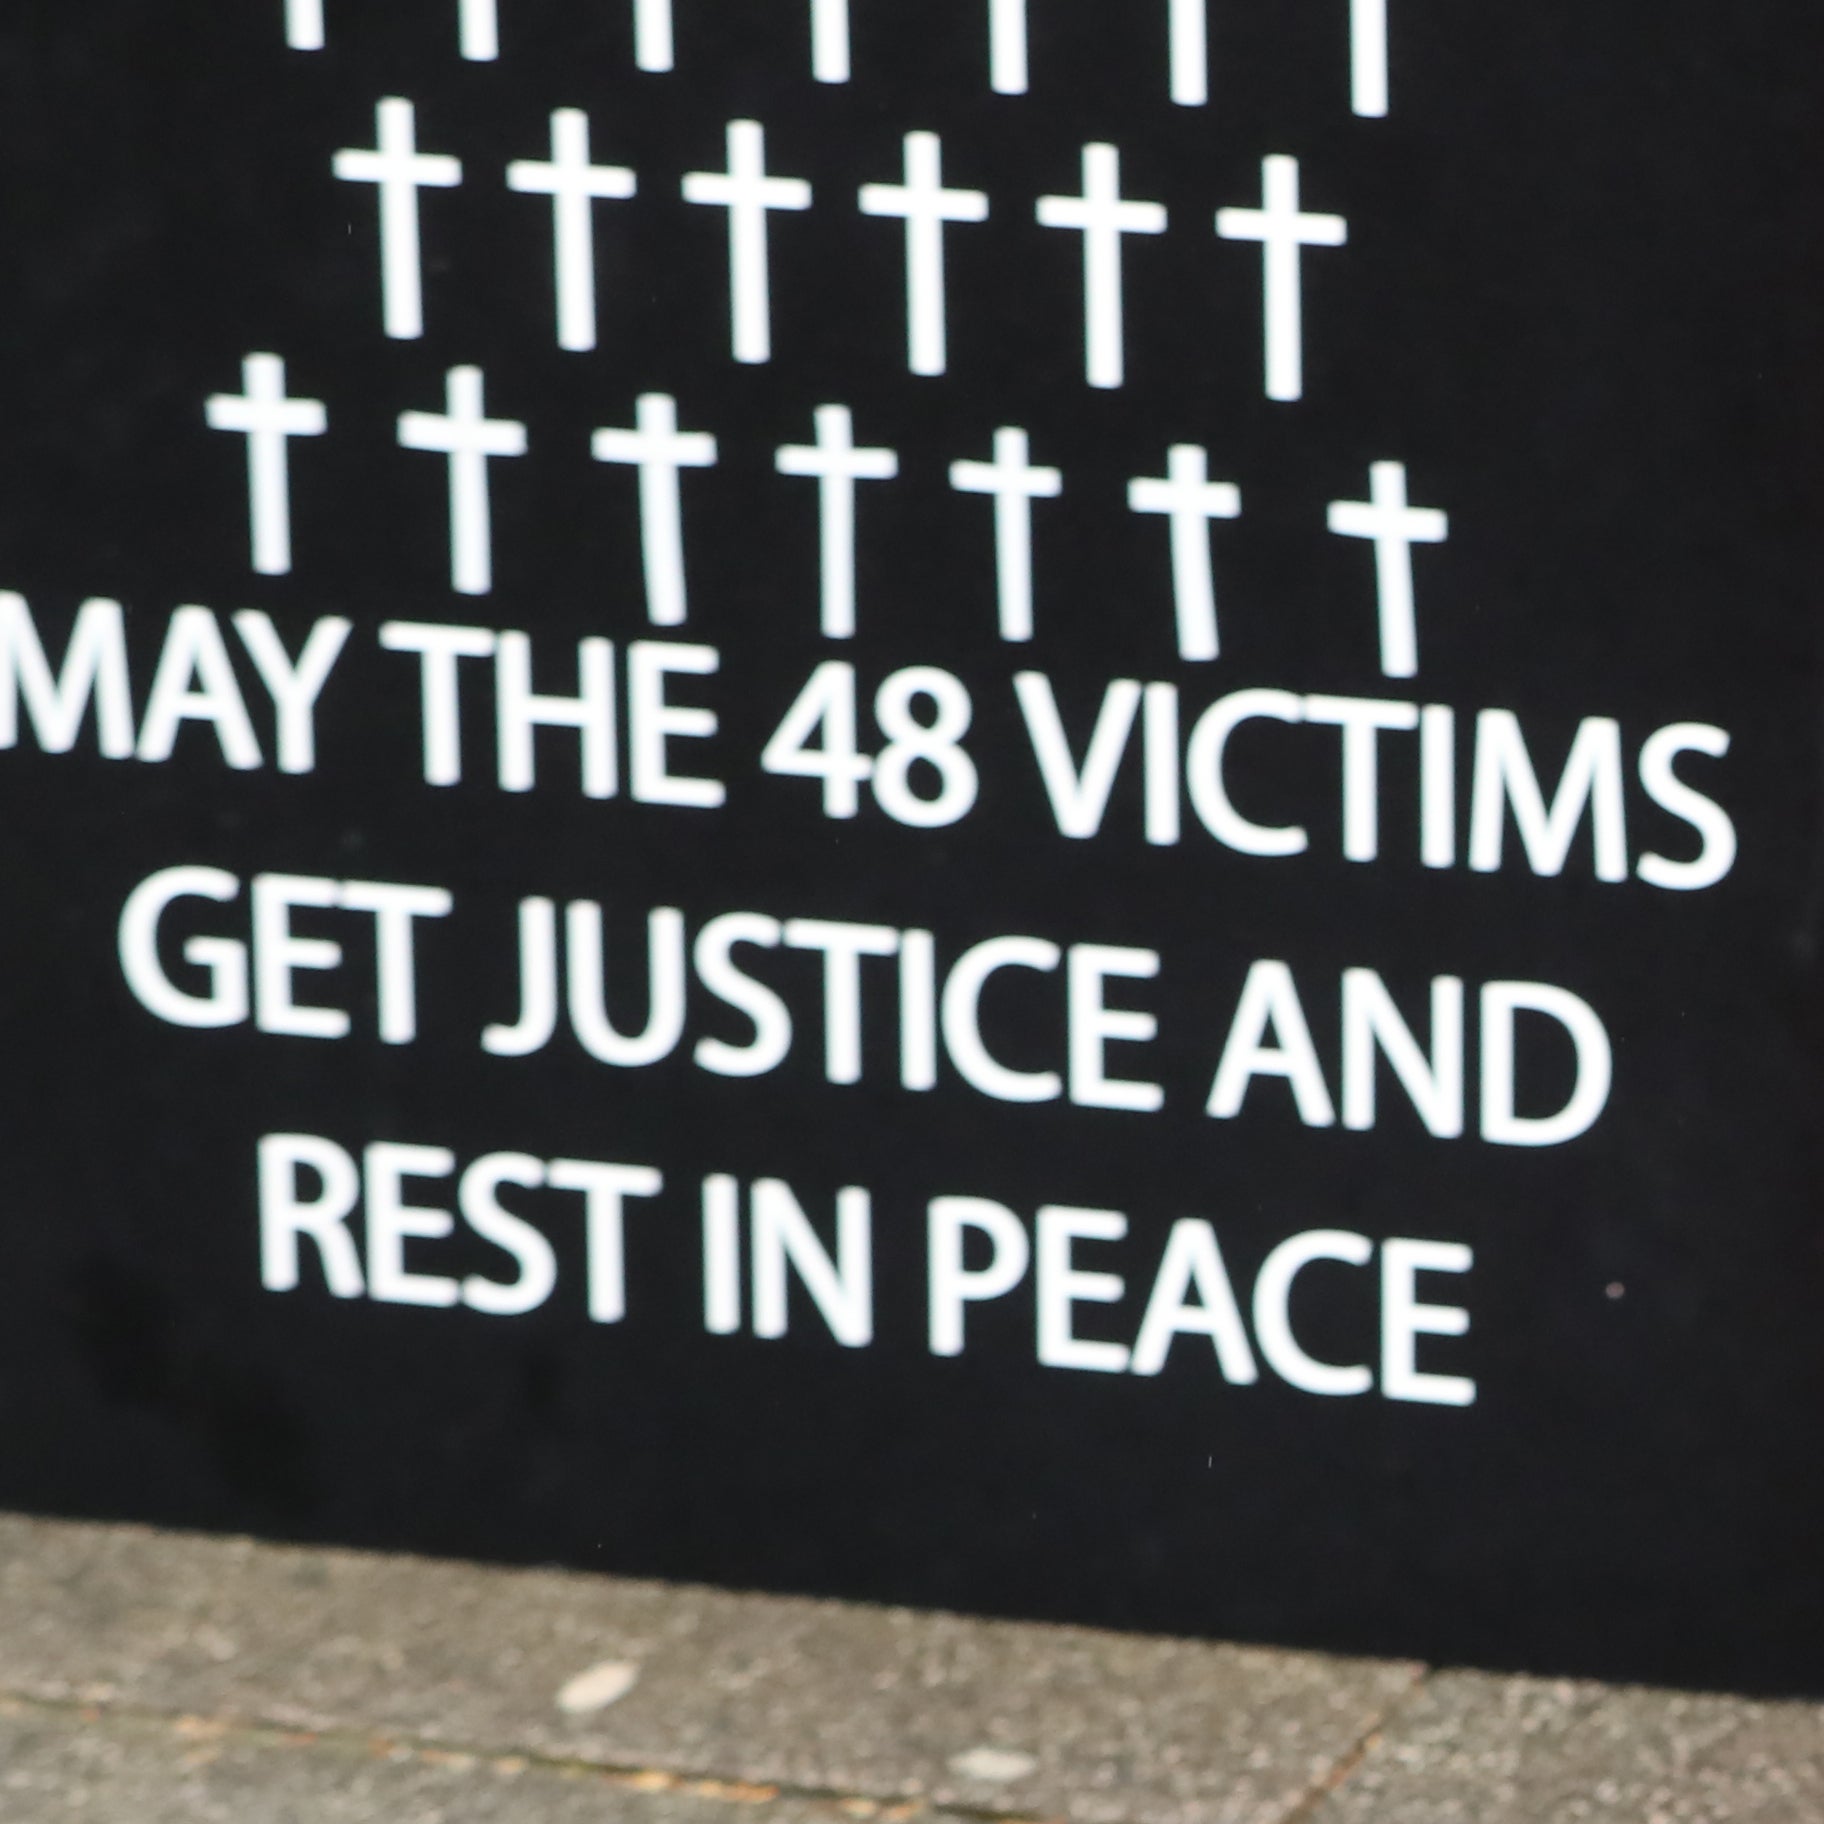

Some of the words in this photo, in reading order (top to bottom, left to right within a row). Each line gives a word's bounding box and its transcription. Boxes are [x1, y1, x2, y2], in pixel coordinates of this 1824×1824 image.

[0, 589, 353, 775] MAY
[378, 619, 727, 809] THE
[760, 659, 980, 838] 48
[1012, 669, 1738, 892] VICTIMS
[117, 864, 454, 1046] GET
[480, 895, 1165, 1113] JUSTICE
[1205, 958, 1615, 1148] AND
[256, 1132, 664, 1324] REST
[701, 1172, 874, 1349] IN
[926, 1194, 1477, 1408] PEACE
